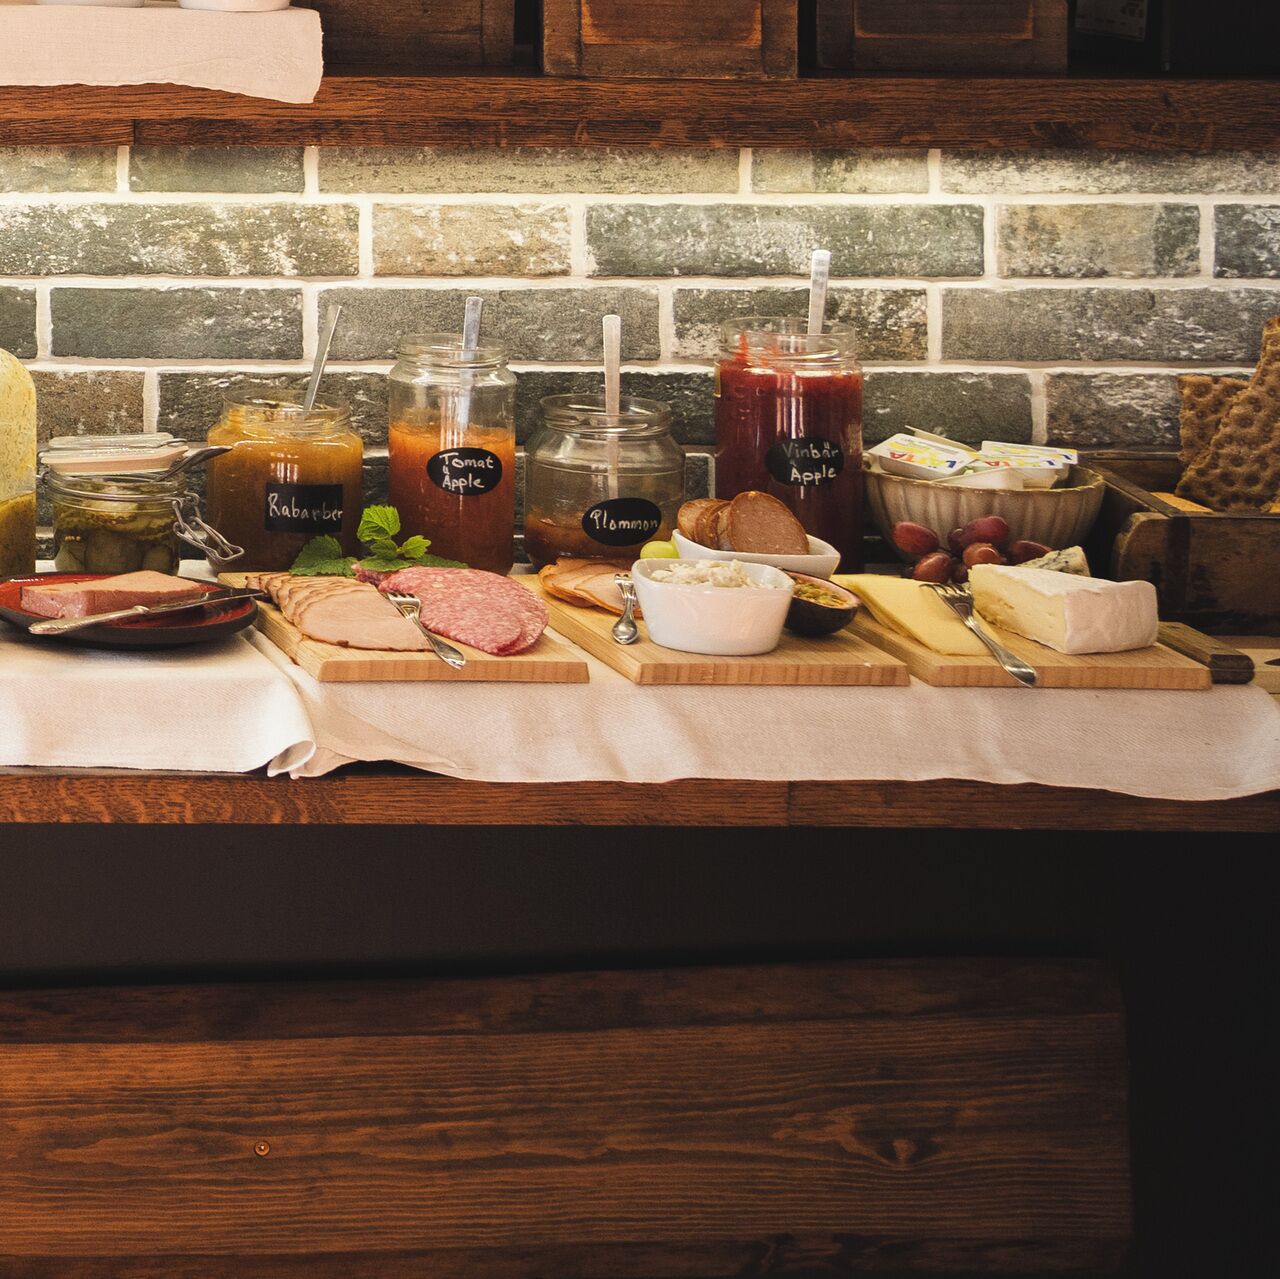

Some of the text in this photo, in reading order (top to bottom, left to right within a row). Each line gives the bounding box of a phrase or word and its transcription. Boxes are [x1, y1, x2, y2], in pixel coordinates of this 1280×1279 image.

[782, 441, 839, 459] Vinbär
[439, 452, 494, 469] Tomat
[267, 492, 344, 521] Rabarber
[589, 509, 658, 531] Plommon
